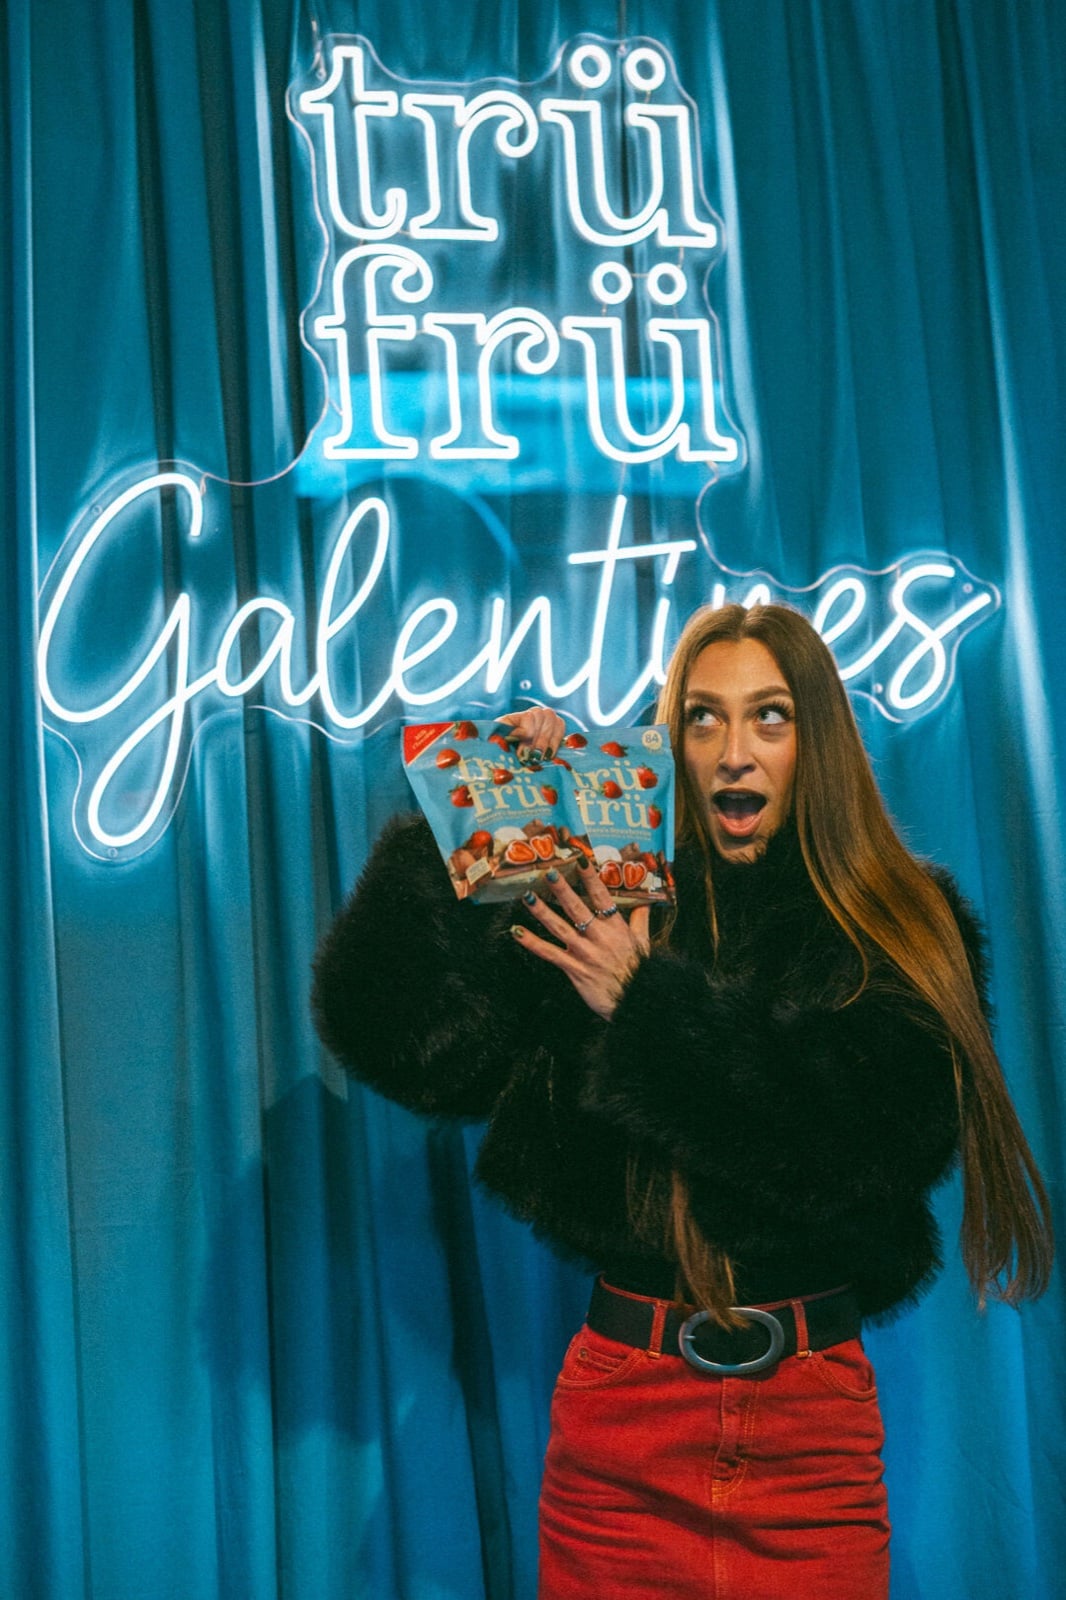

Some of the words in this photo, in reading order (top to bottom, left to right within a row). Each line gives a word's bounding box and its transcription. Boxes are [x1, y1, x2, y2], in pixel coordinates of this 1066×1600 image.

[300, 46, 716, 248] trü
[315, 244, 737, 463] frü
[37, 471, 992, 848] Galenties
[467, 776, 549, 817] frü
[571, 760, 645, 791] trü
[577, 790, 650, 829] frü
